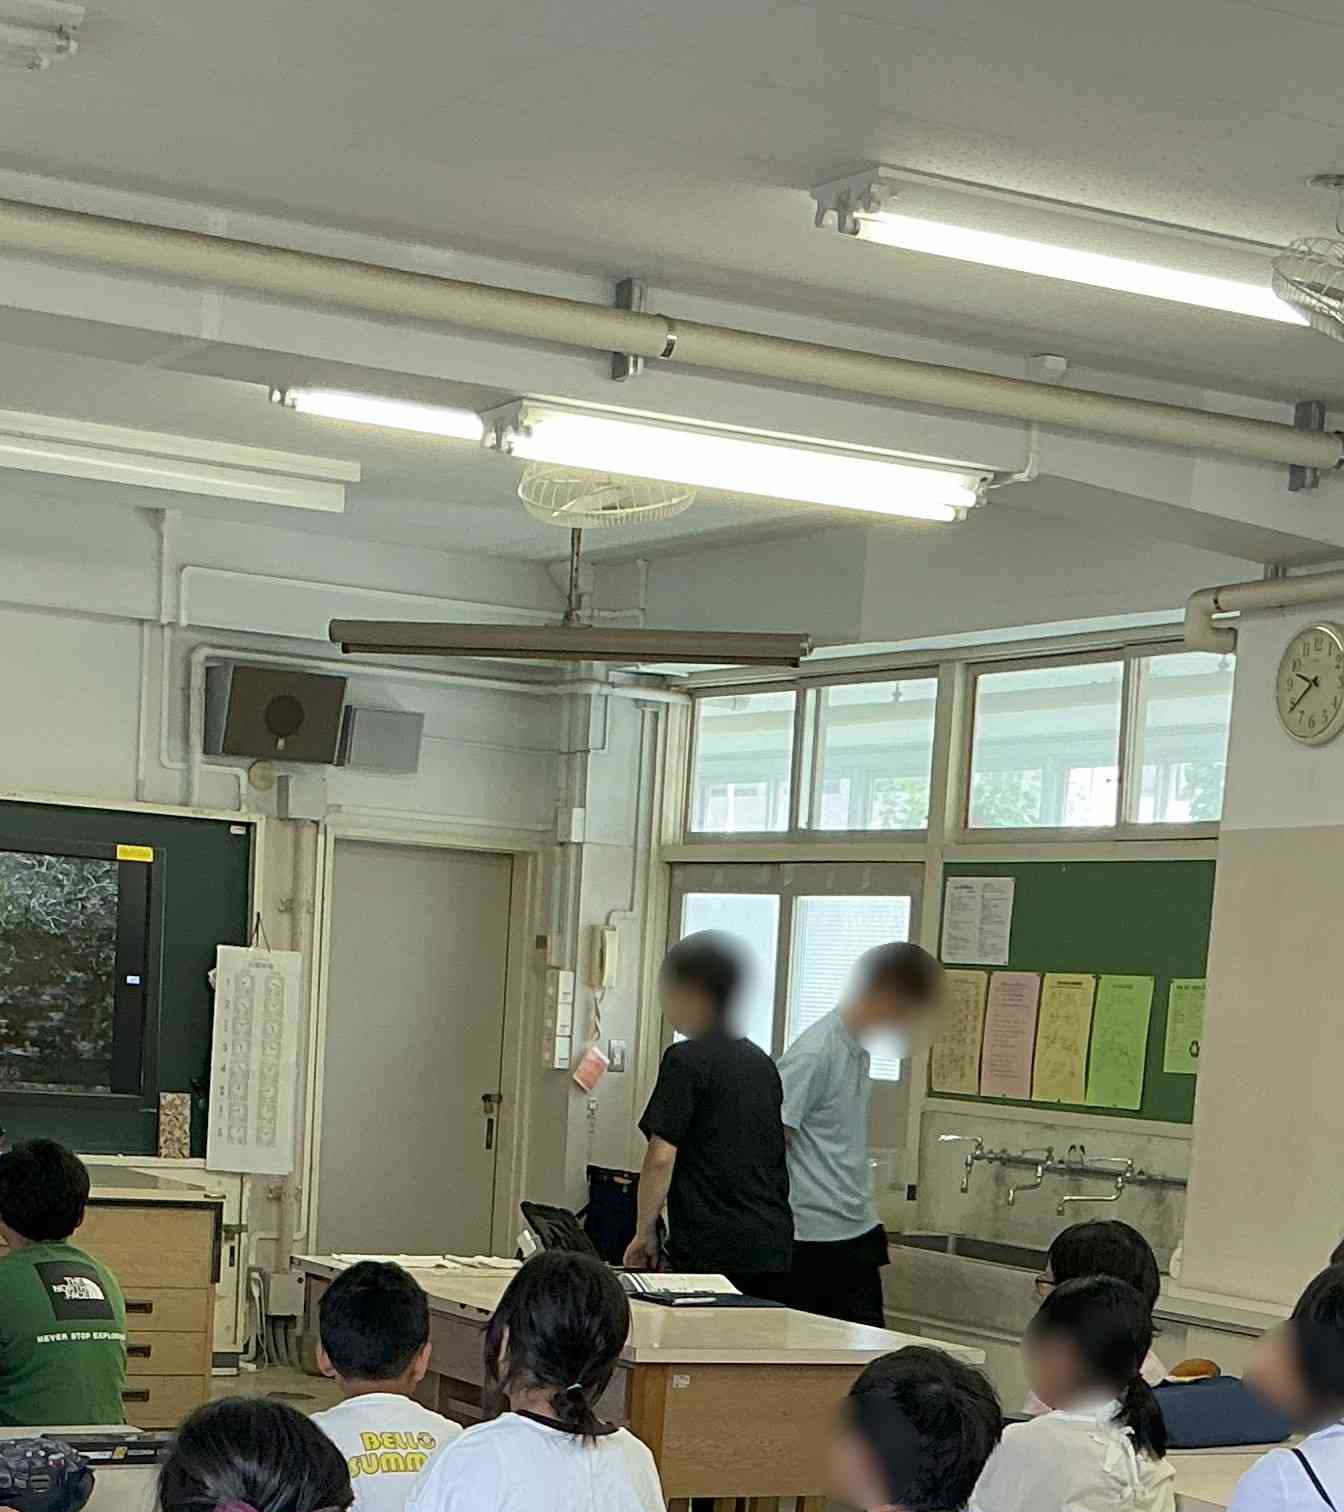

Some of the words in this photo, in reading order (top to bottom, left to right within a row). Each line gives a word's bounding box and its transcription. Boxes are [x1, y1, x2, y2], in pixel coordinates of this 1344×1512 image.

[36, 1332, 69, 1343] NEVER
[360, 1431, 436, 1451] BELLO
[347, 1452, 429, 1478] SUMM
